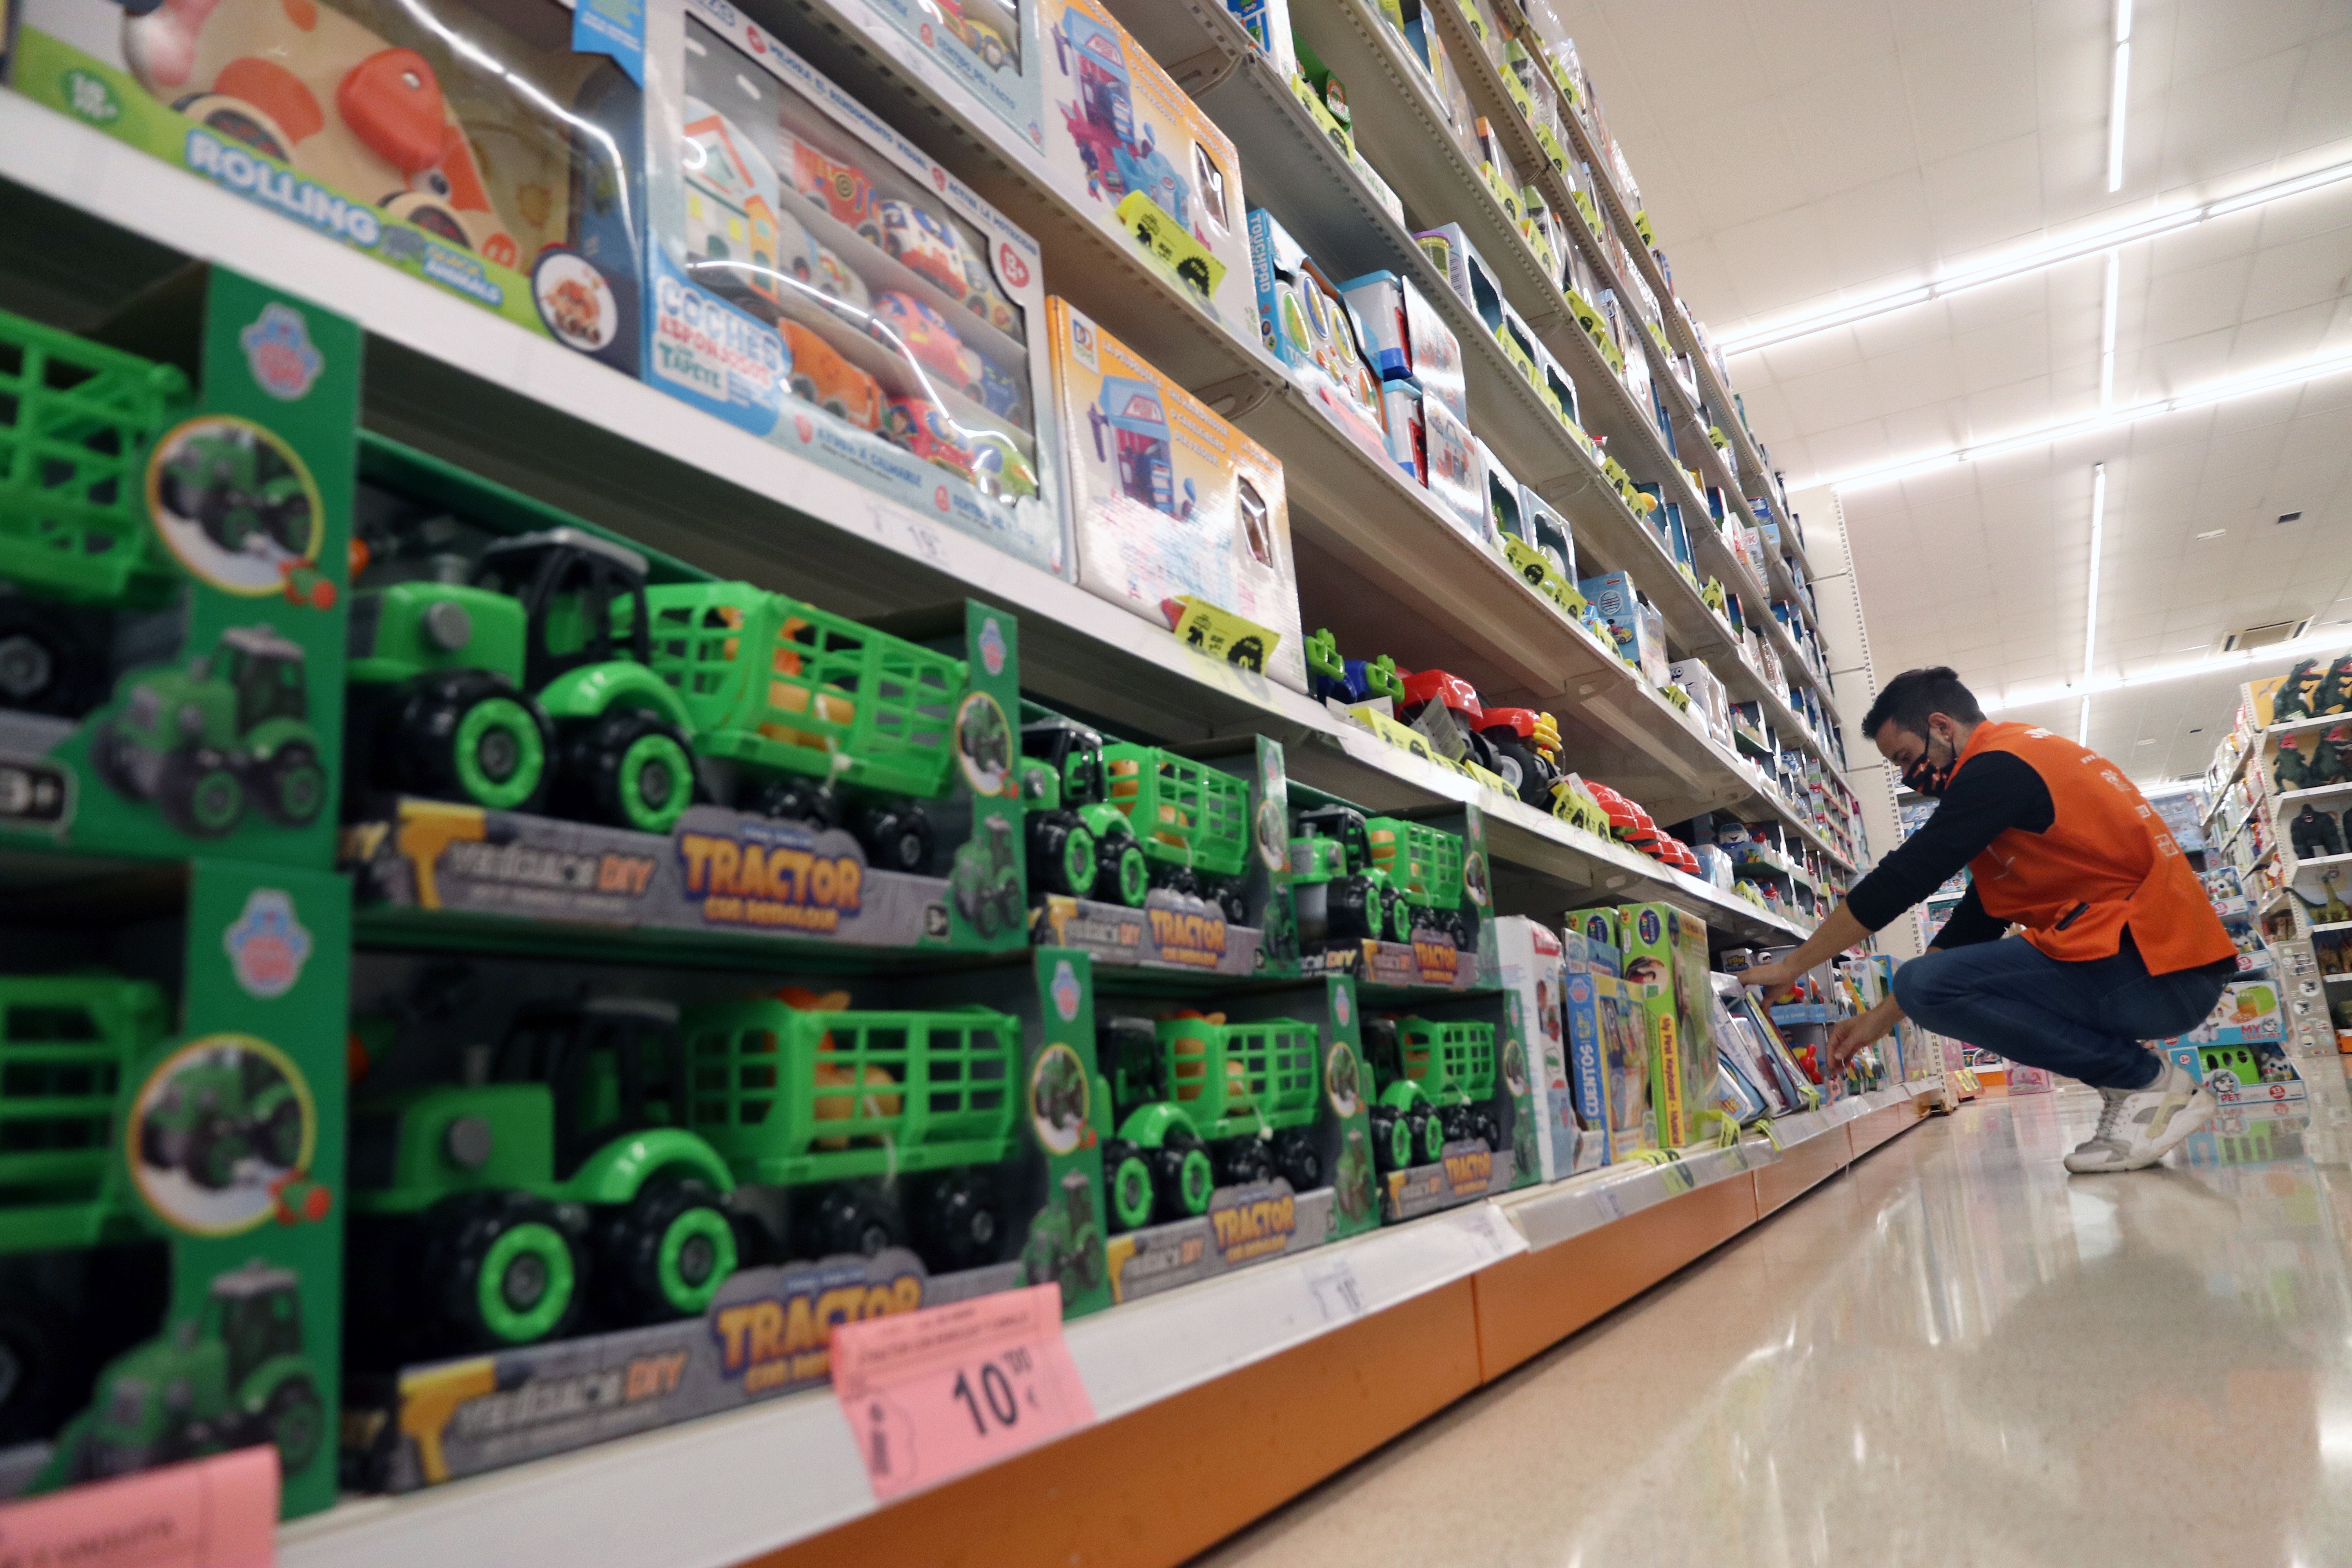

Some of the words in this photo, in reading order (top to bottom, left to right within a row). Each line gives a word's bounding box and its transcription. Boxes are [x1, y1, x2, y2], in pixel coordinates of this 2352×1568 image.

[191, 131, 379, 247] ROLLING
[1250, 213, 1271, 294] TOUCHPAD
[661, 281, 779, 371] COCHES
[598, 855, 655, 893] DIY
[681, 833, 860, 909] TRACTOR
[1149, 909, 1227, 952] TRACTOR
[1326, 948, 1358, 968] DIY
[1414, 942, 1457, 972] TRACTOR
[1662, 1017, 1671, 1031] My
[1664, 1034, 1673, 1055] First
[2241, 1024, 2261, 1034] MY
[1580, 1044, 1599, 1116] CUENTOS
[1665, 1058, 1677, 1101] Keyboard
[2221, 1093, 2240, 1102] PET
[1671, 1110, 1682, 1144] Musical
[1445, 1151, 1492, 1186] TRACTOR
[1213, 1194, 1295, 1250] TRACTOR
[719, 1275, 921, 1369] TRACTOR
[627, 1352, 688, 1401] DIY
[953, 1362, 1019, 1437] 10
